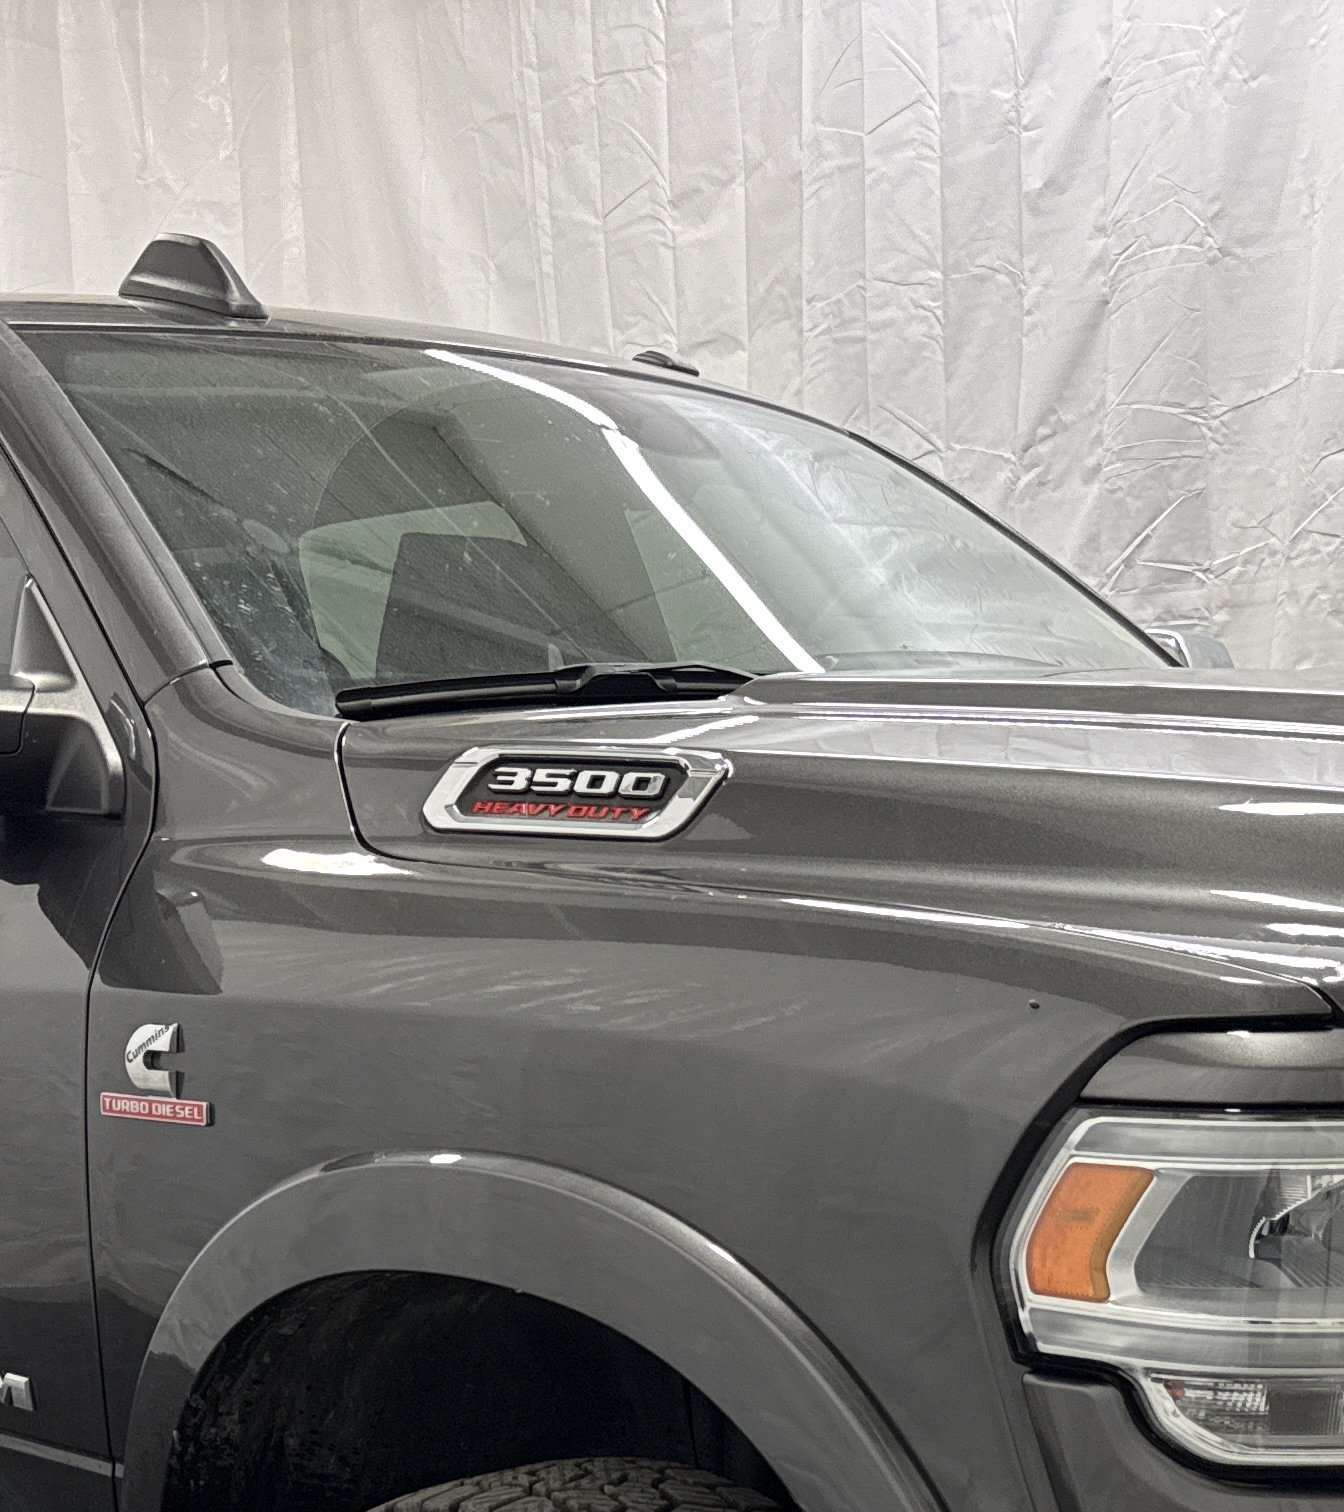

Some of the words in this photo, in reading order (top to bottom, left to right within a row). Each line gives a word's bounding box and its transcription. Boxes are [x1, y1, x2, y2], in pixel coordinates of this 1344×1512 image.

[488, 766, 669, 798] 3500
[470, 800, 567, 819] HEAVY
[566, 804, 650, 822] DUTY
[126, 1024, 171, 1063] Cummins
[103, 1097, 150, 1115] TURBO
[151, 1102, 203, 1121] DIESEL
